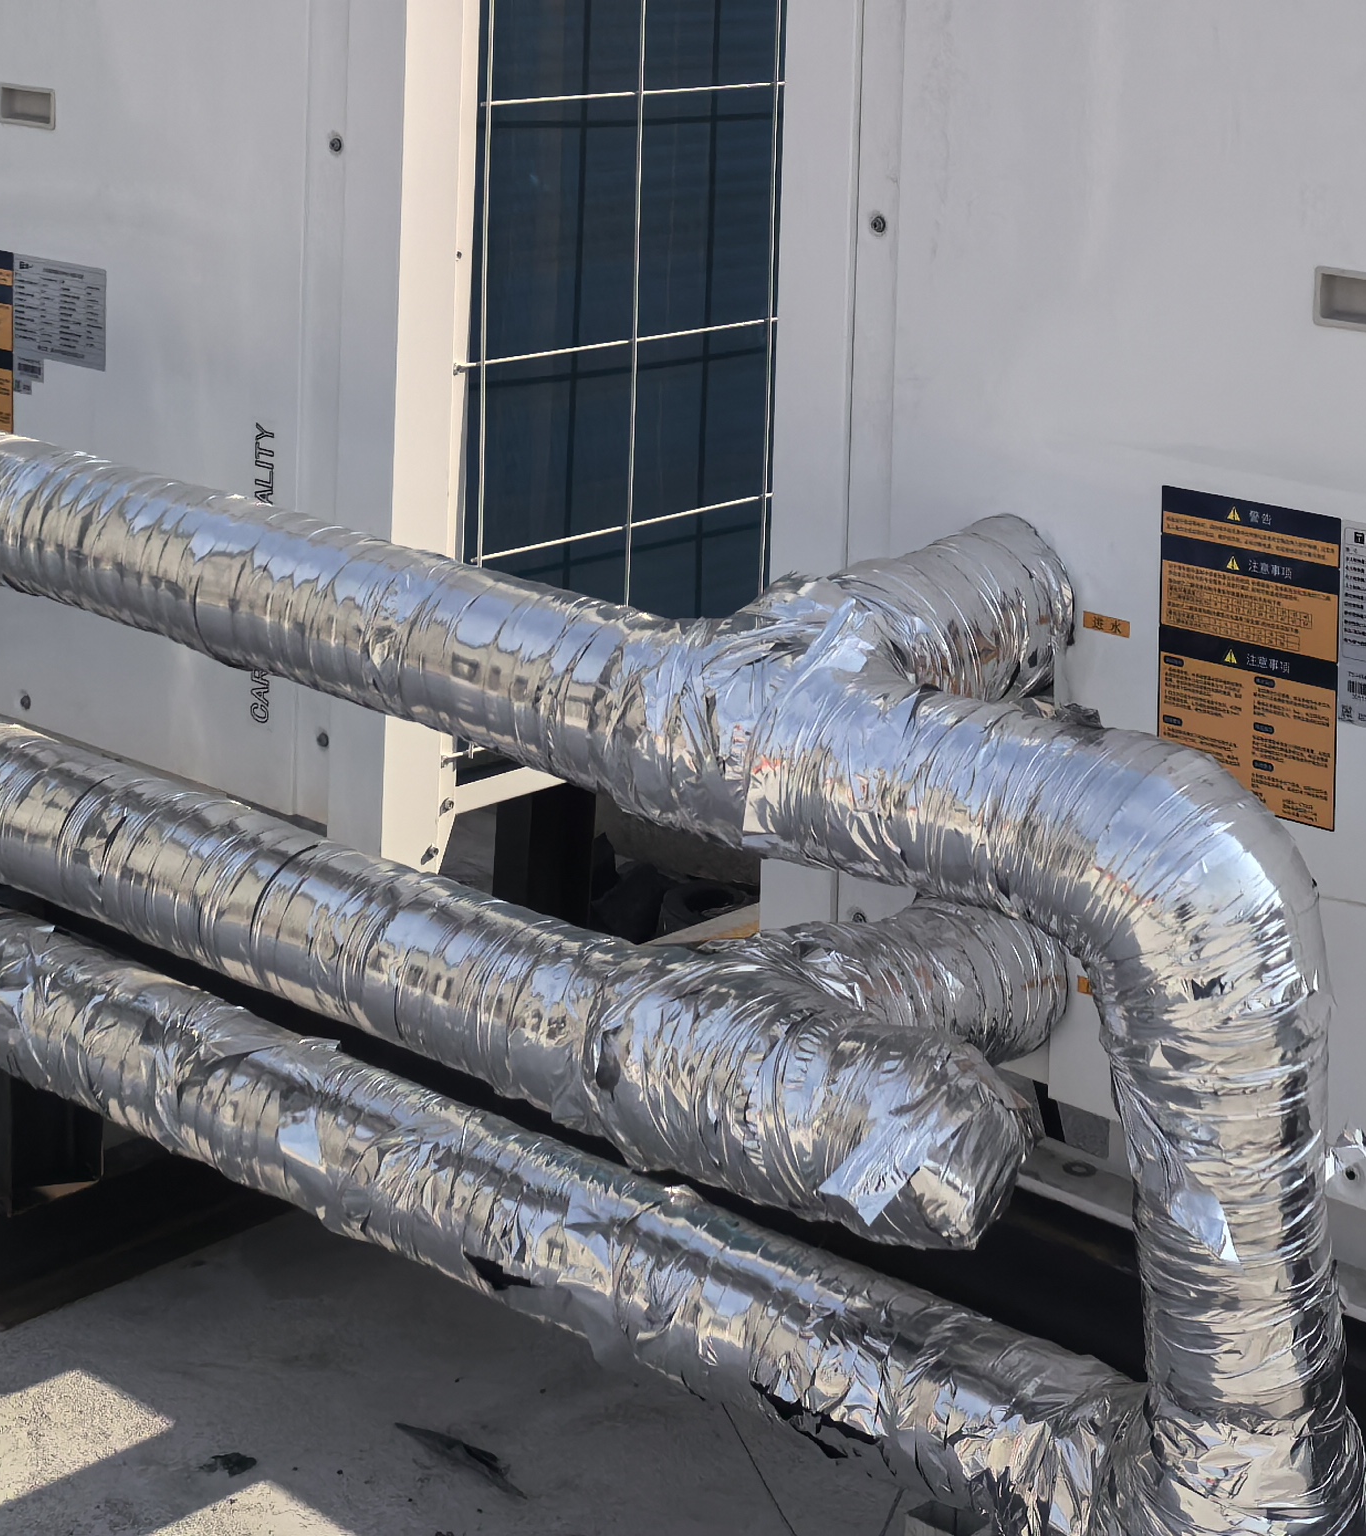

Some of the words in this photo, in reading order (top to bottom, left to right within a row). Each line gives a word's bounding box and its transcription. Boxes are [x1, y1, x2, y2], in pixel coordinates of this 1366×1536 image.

[254, 421, 275, 505] ALITY
[1248, 509, 1273, 526] 警告
[1247, 558, 1293, 580] 注意事项
[1245, 652, 1291, 675] 注意事项
[250, 667, 270, 724] CAR
